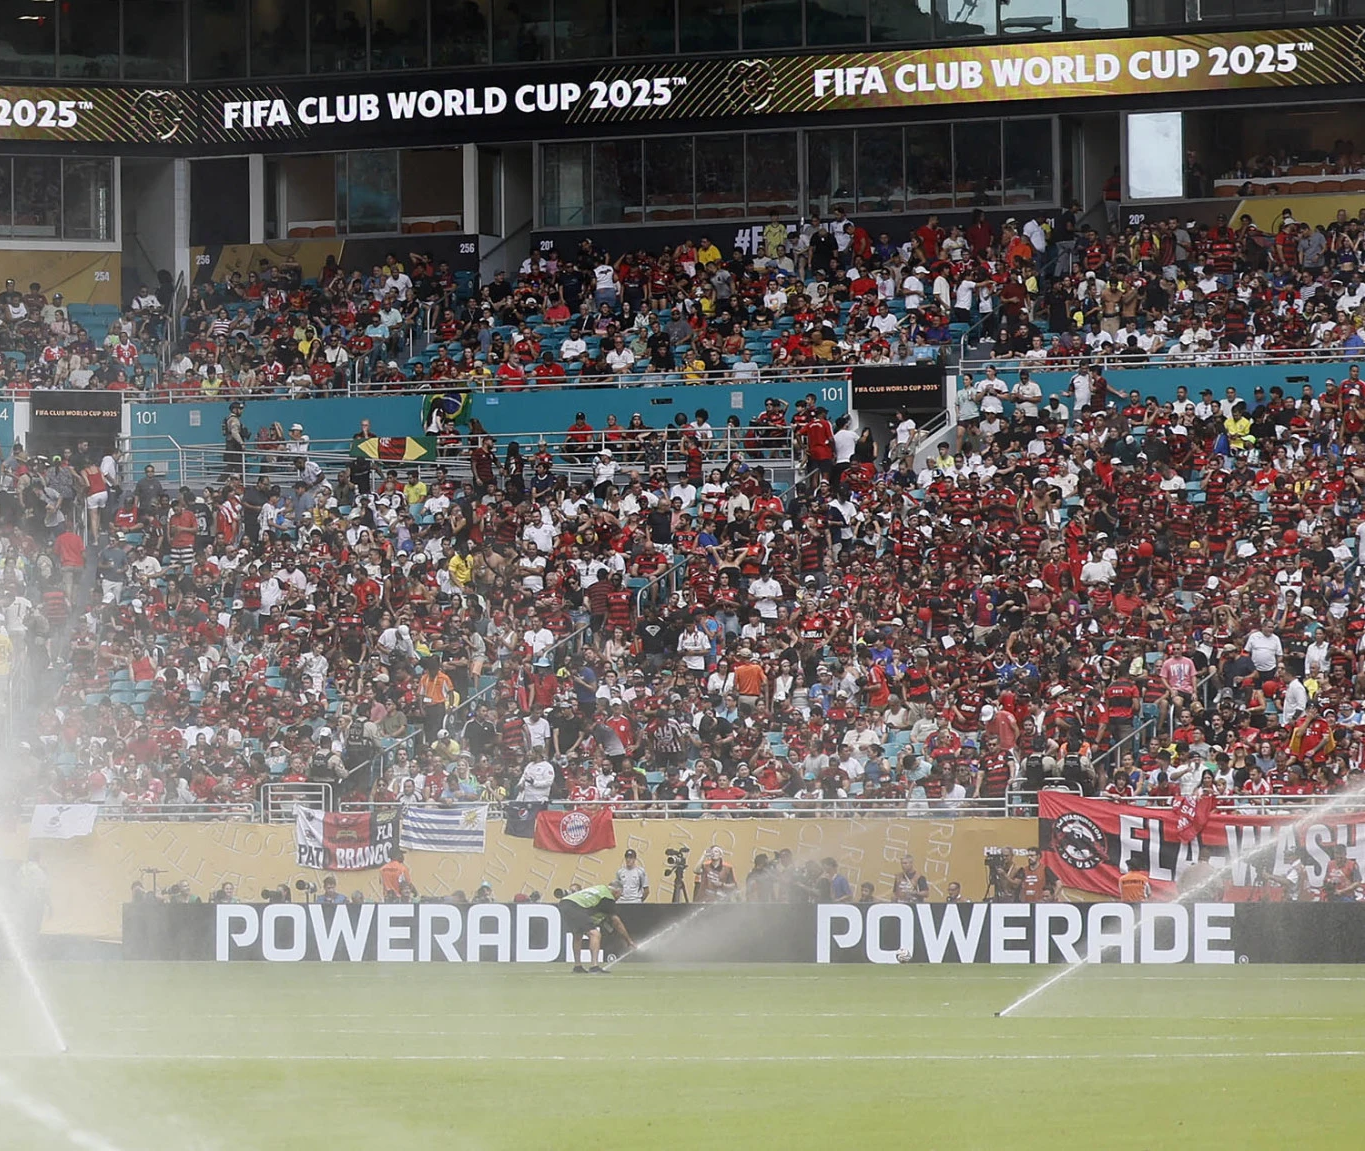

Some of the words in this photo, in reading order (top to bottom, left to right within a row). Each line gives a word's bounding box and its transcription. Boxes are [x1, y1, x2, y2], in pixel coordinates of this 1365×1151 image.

[815, 67, 887, 97] FIFA
[895, 61, 983, 92] CLUB
[991, 54, 1120, 86] WORLD
[1129, 49, 1199, 79] CUP
[224, 100, 291, 128] FIFA
[298, 94, 379, 124] CLUB
[388, 87, 506, 119] WORLD
[516, 83, 580, 112] CUP
[196, 255, 210, 264] 256
[821, 388, 843, 401] 101
[869, 385, 884, 393] CLUB
[886, 385, 908, 393] WORLD
[136, 411, 157, 424] 101
[216, 904, 603, 962] POWERAD
[816, 904, 1235, 963] POWERADE
